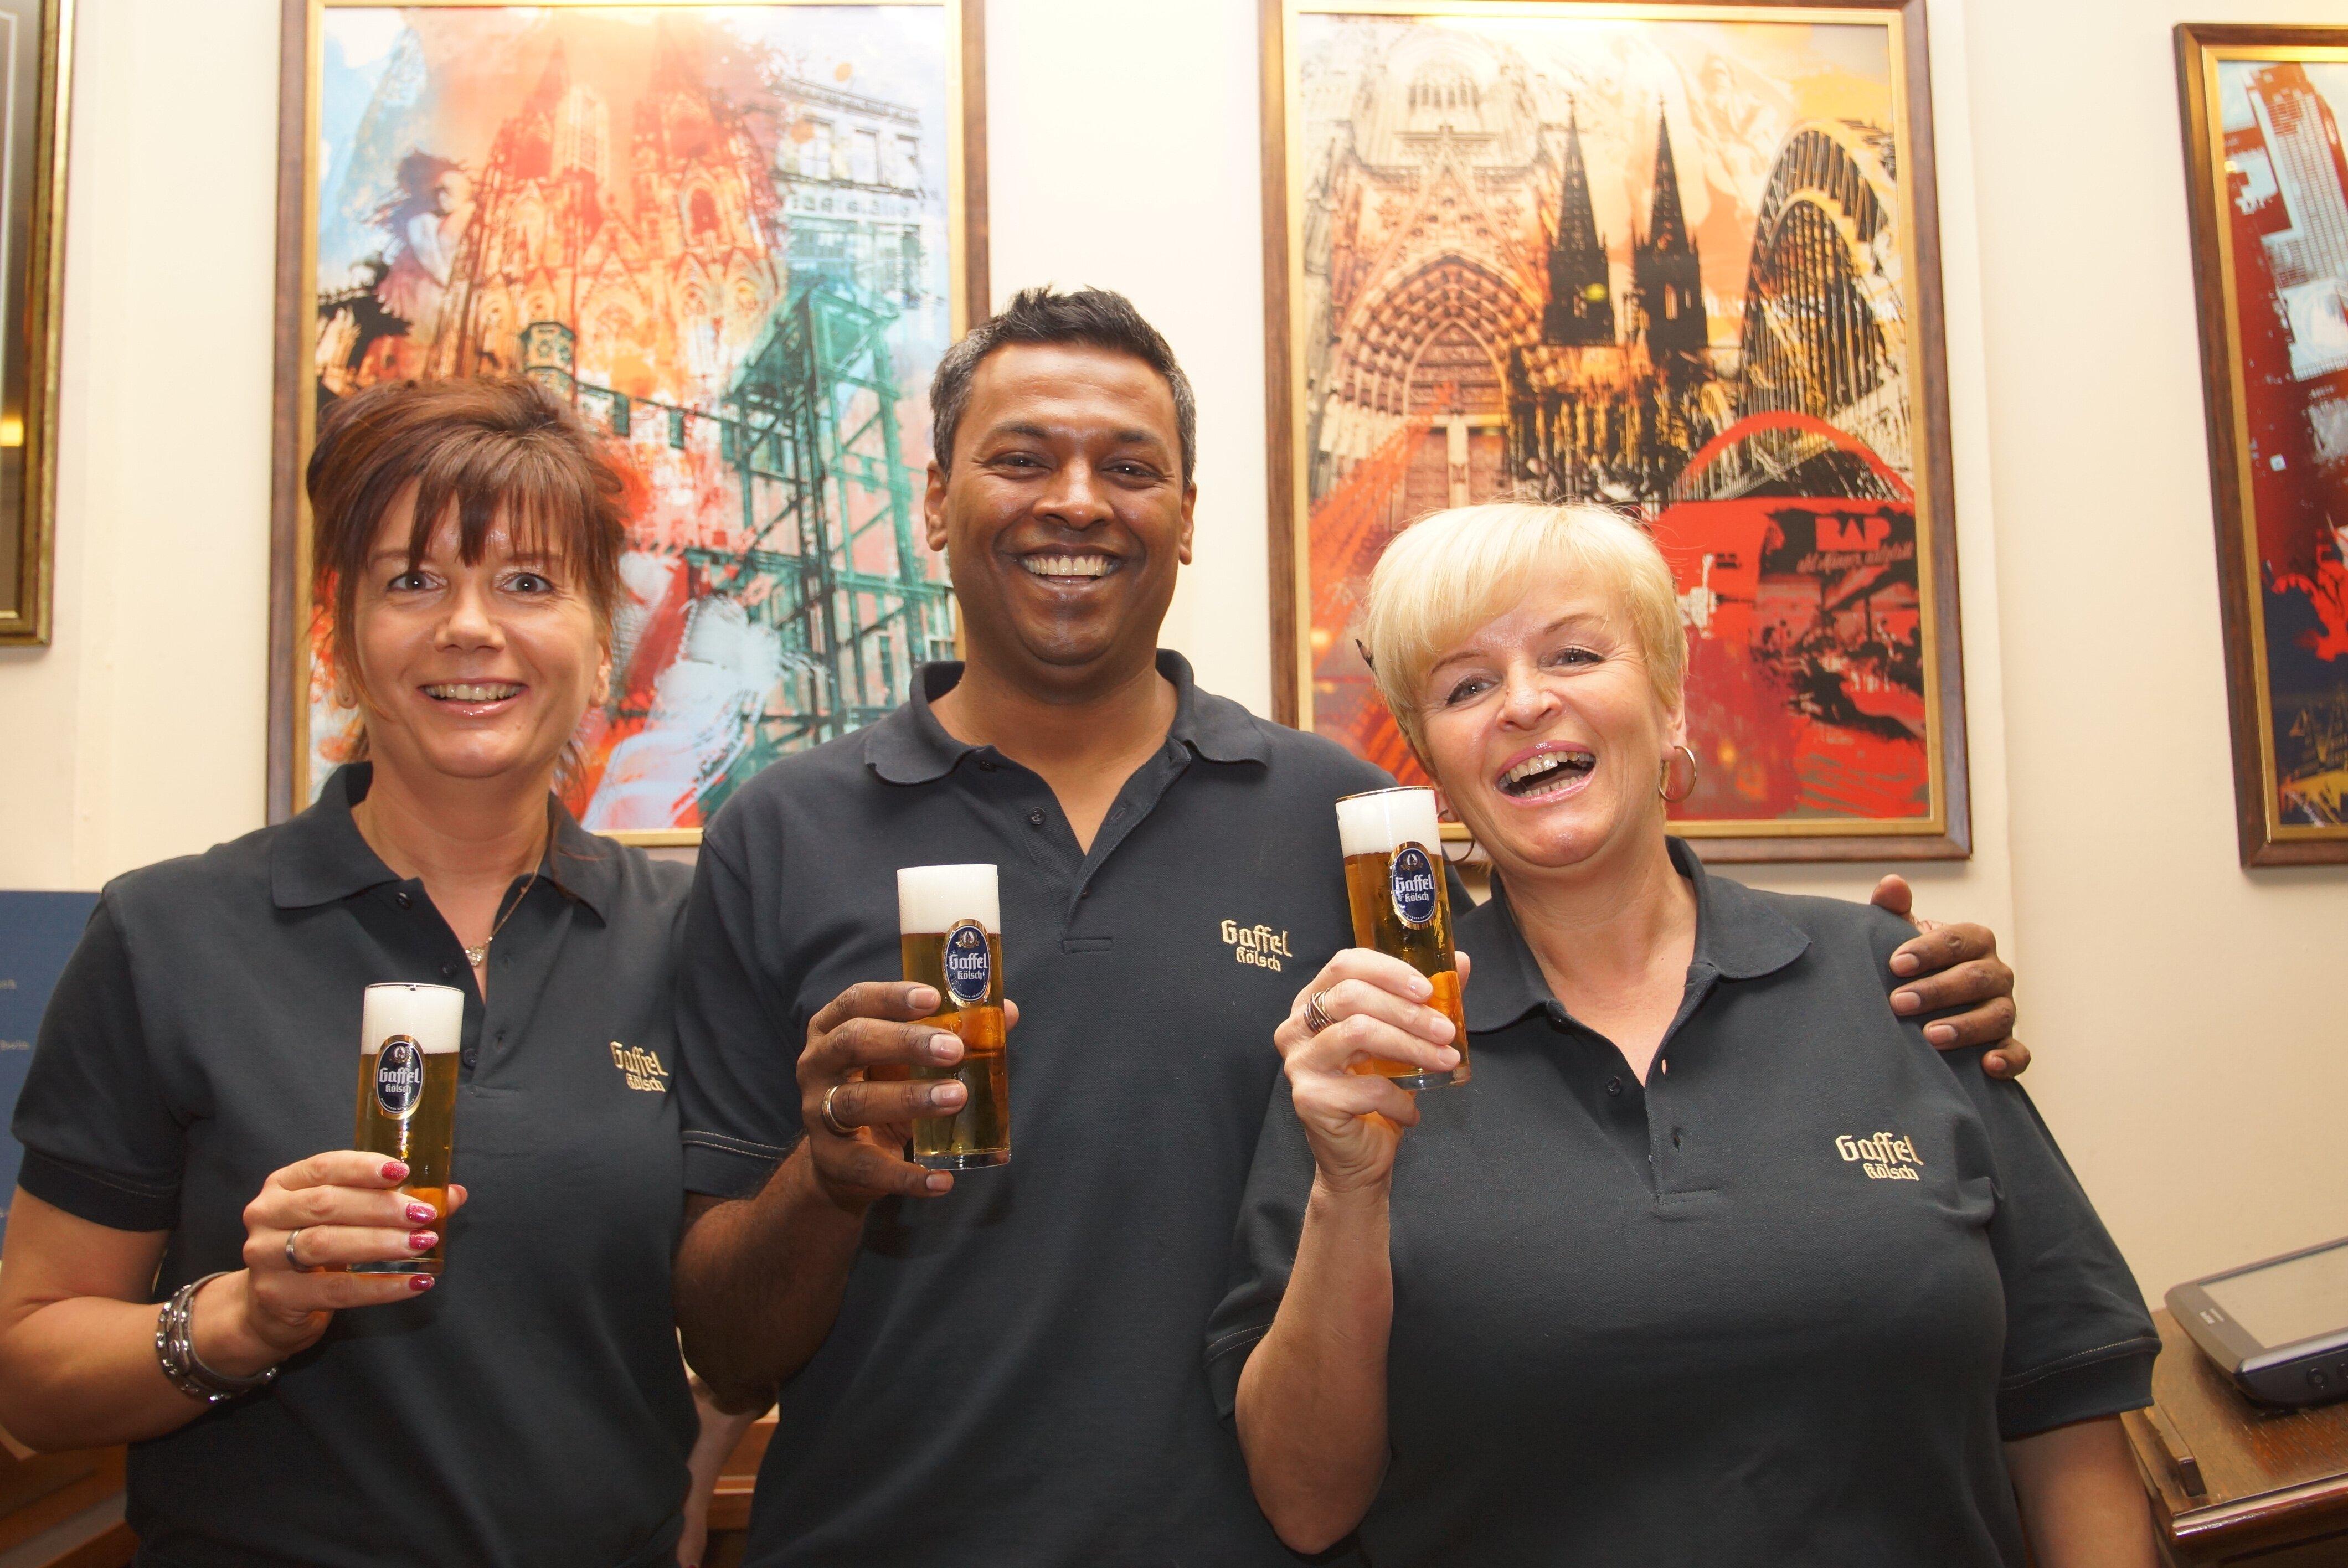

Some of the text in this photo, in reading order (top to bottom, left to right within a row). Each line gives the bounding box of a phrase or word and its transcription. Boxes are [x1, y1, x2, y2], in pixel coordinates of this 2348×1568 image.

[1395, 874, 1434, 893] Gaffel
[1405, 891, 1429, 902] Kölsch
[1221, 920, 1293, 957] Gaffel
[949, 953, 988, 970] Gaffel
[1236, 946, 1281, 972] Kölsch
[957, 970, 982, 980] Kölsch
[610, 1041, 669, 1077] Gaffel
[379, 1067, 420, 1084] Gaffel
[385, 1084, 411, 1093] Kölsch
[1835, 1132, 1924, 1165] Gaffel
[1863, 1163, 1919, 1181] Kölsch
